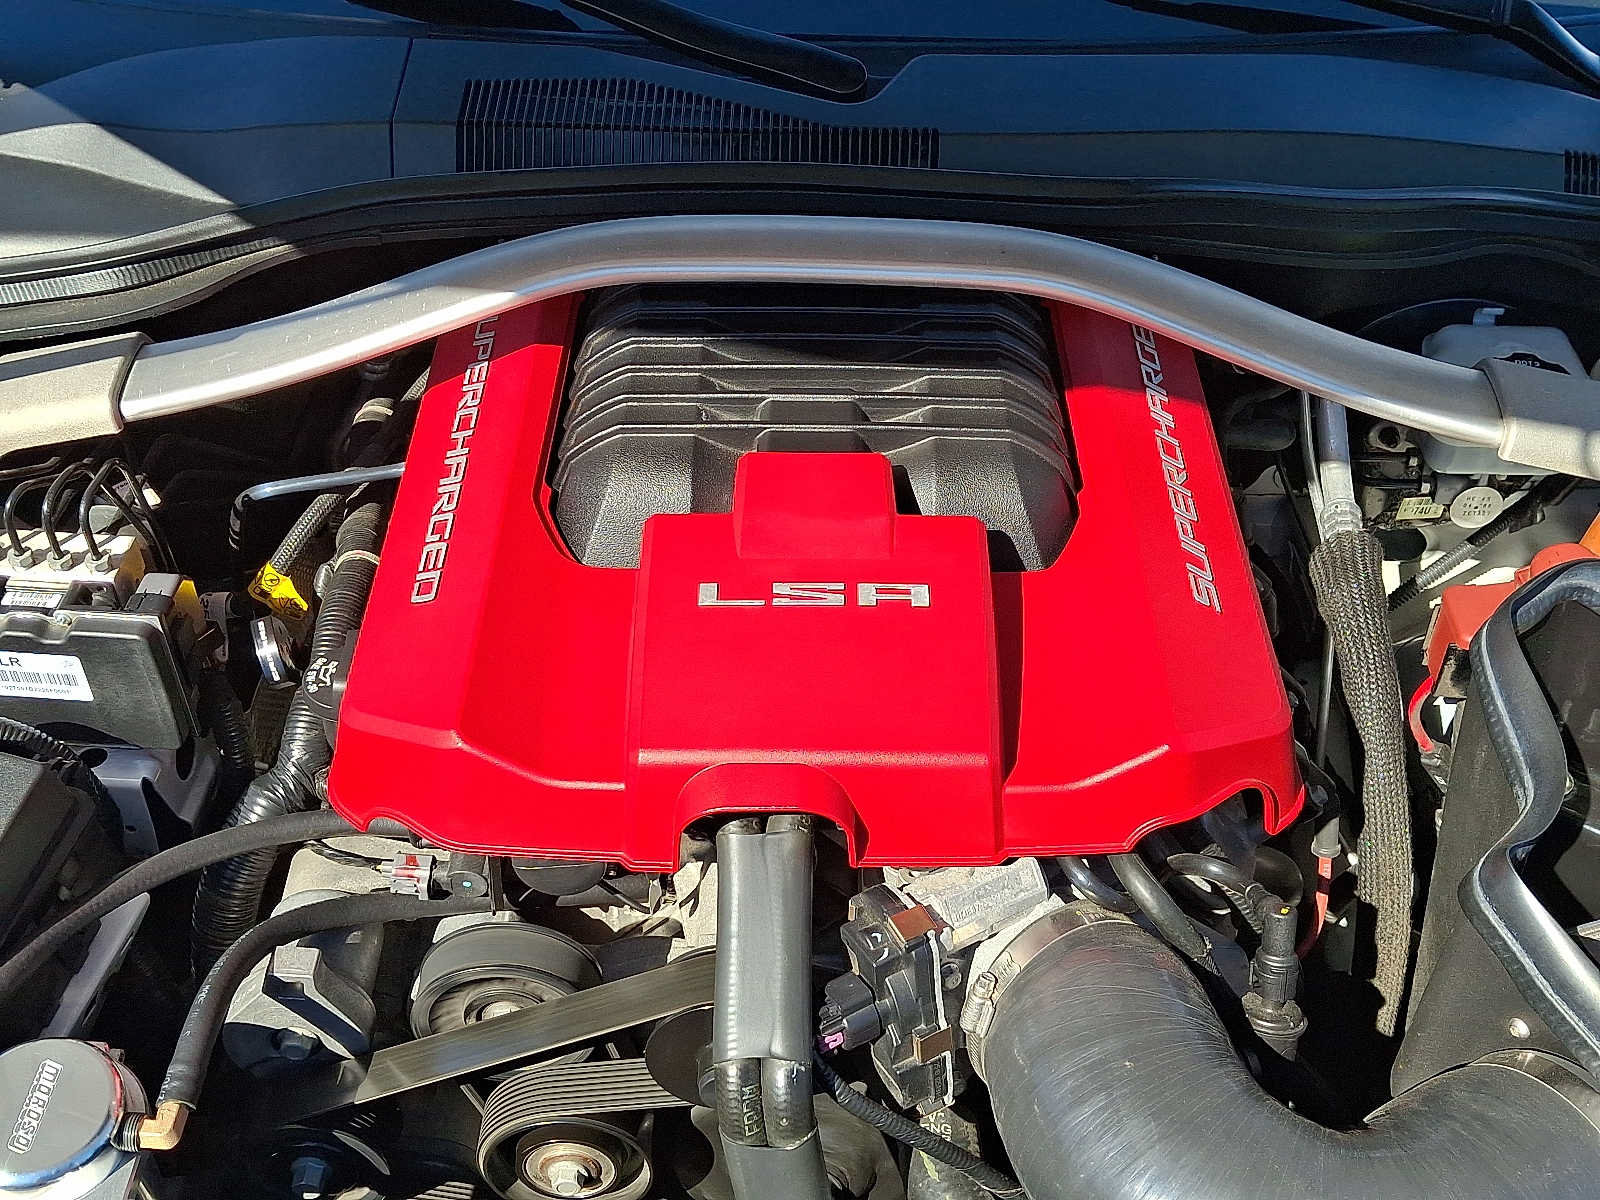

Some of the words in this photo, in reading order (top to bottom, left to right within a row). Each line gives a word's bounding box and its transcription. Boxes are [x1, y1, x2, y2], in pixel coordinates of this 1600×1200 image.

[410, 316, 499, 605] UPERCHARGED
[1131, 323, 1222, 614] SUPERCHARGE
[697, 582, 931, 608] LSA
[7, 1058, 64, 1154] MOROSO
